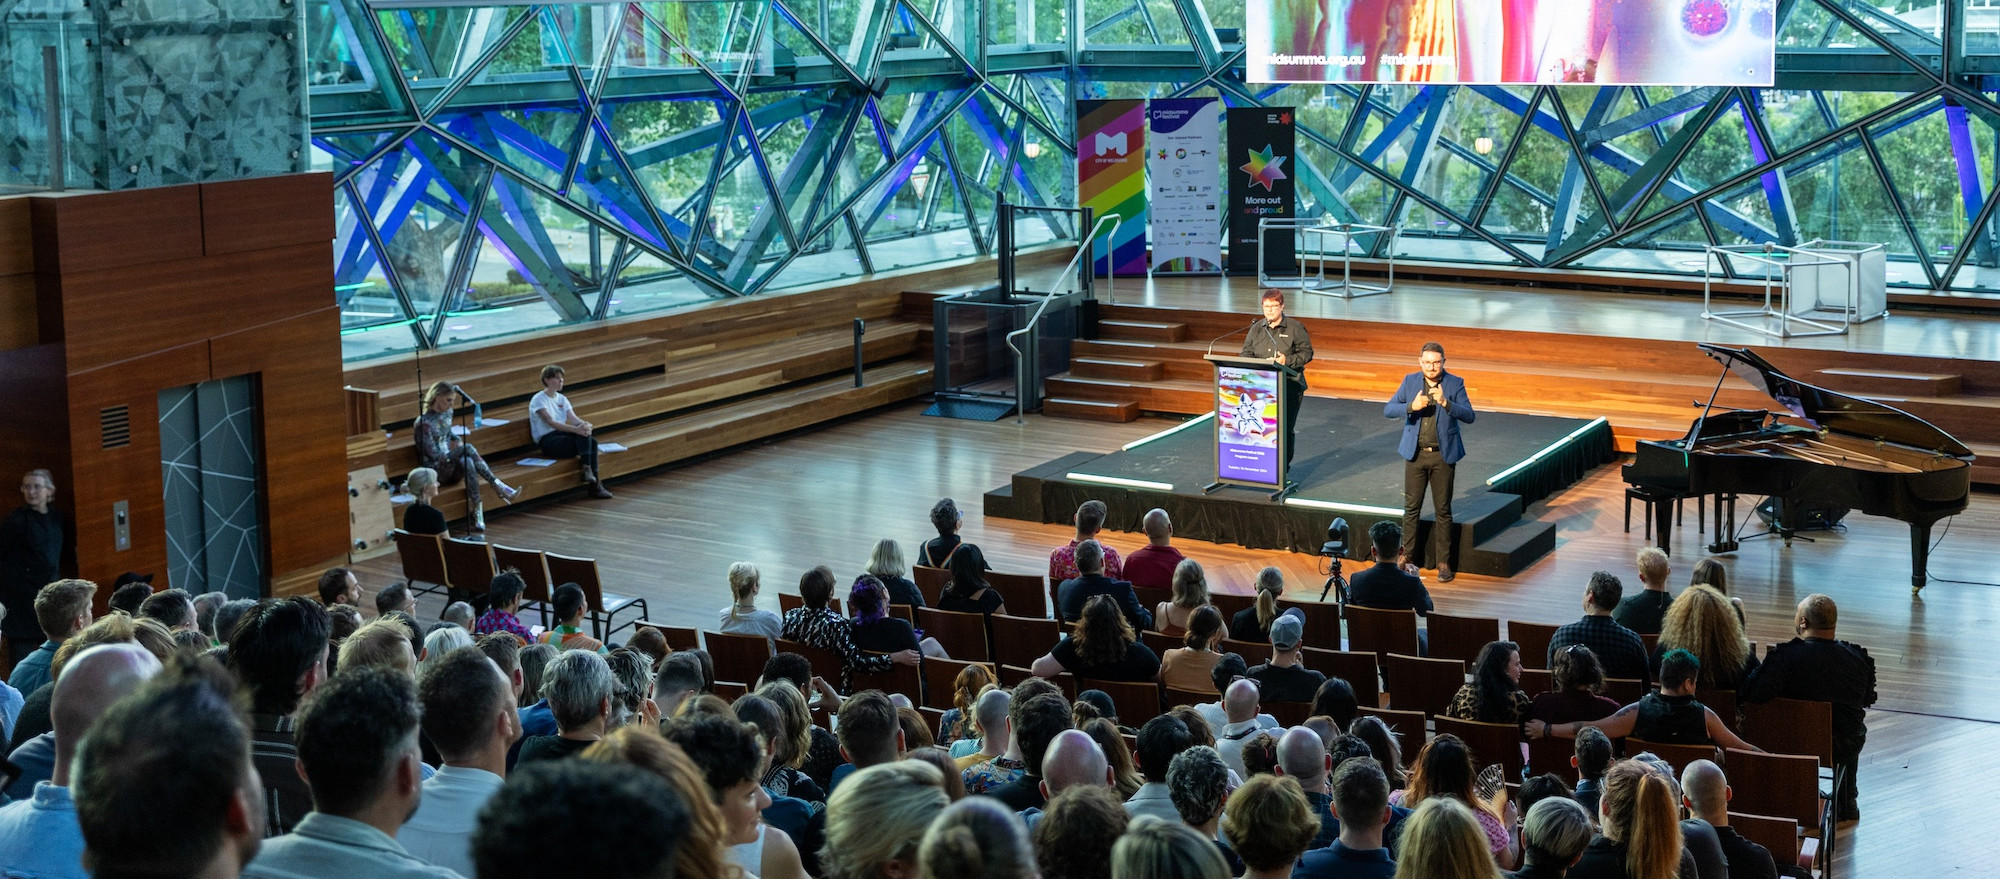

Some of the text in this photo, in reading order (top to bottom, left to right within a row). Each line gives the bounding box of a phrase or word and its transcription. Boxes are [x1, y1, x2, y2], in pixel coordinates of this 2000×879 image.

[1263, 53, 1365, 67] midsumma.org.au
[1245, 196, 1282, 204] More out
[1260, 206, 1284, 215] proud
